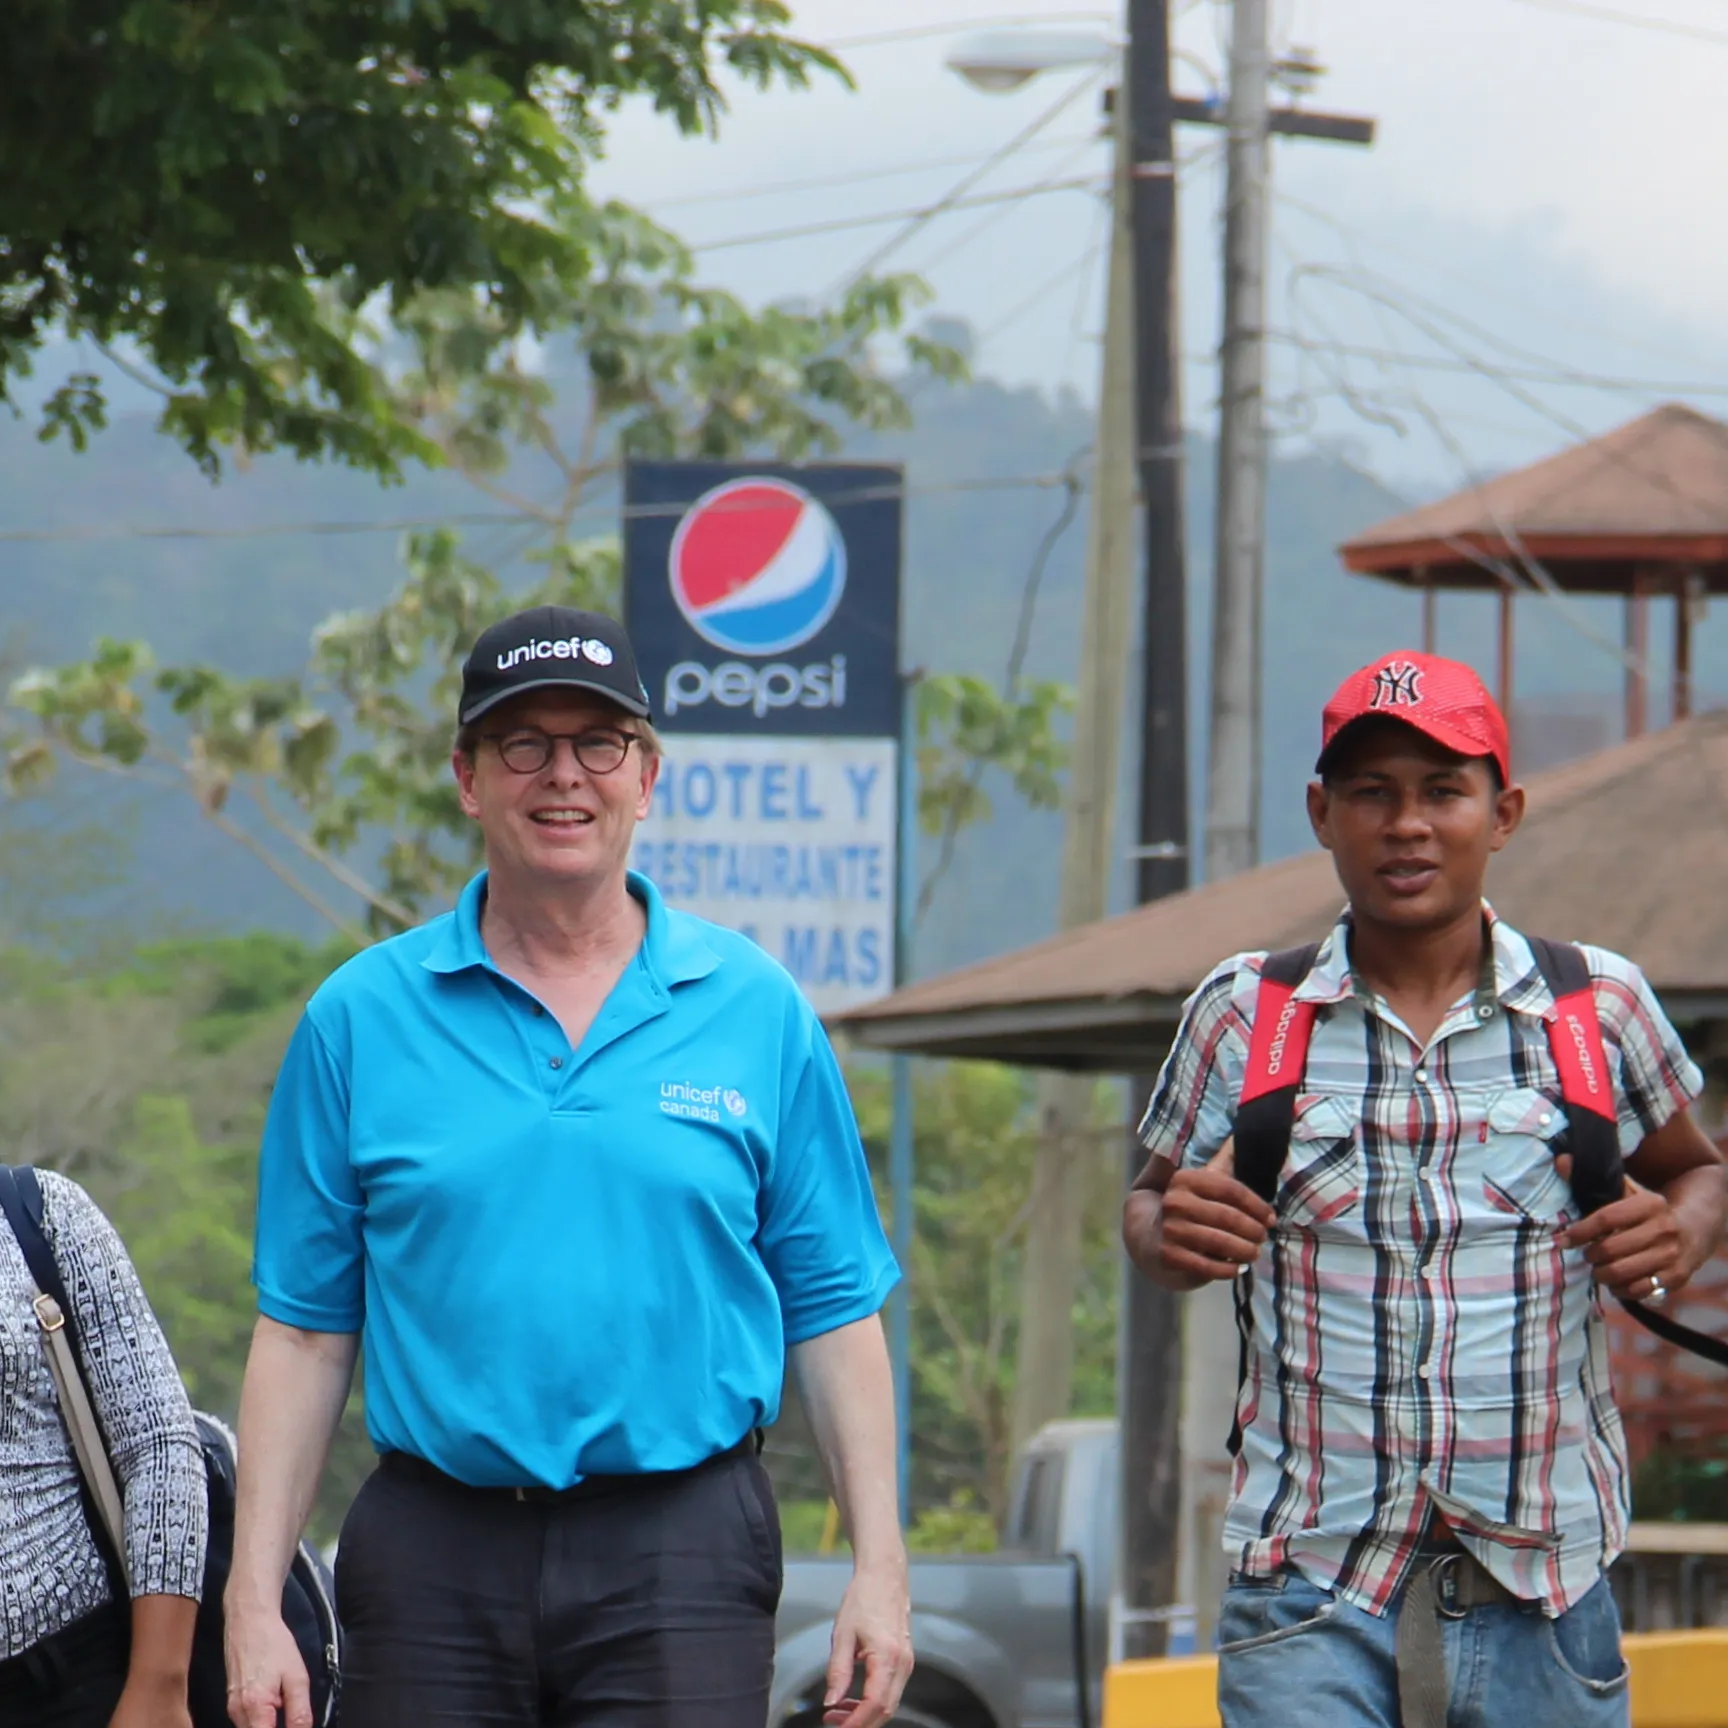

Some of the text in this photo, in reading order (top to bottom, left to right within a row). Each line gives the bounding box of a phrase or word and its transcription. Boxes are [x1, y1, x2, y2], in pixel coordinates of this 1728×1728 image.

[496, 637, 581, 671] unicef
[664, 654, 847, 719] pepsi
[652, 764, 879, 821] HOTEL Y
[635, 843, 881, 899] RESTAURANTE
[784, 923, 880, 986] MAS
[1566, 1014, 1599, 1094] adibags
[659, 1100, 720, 1122] canada
[660, 1081, 721, 1105] unicef
